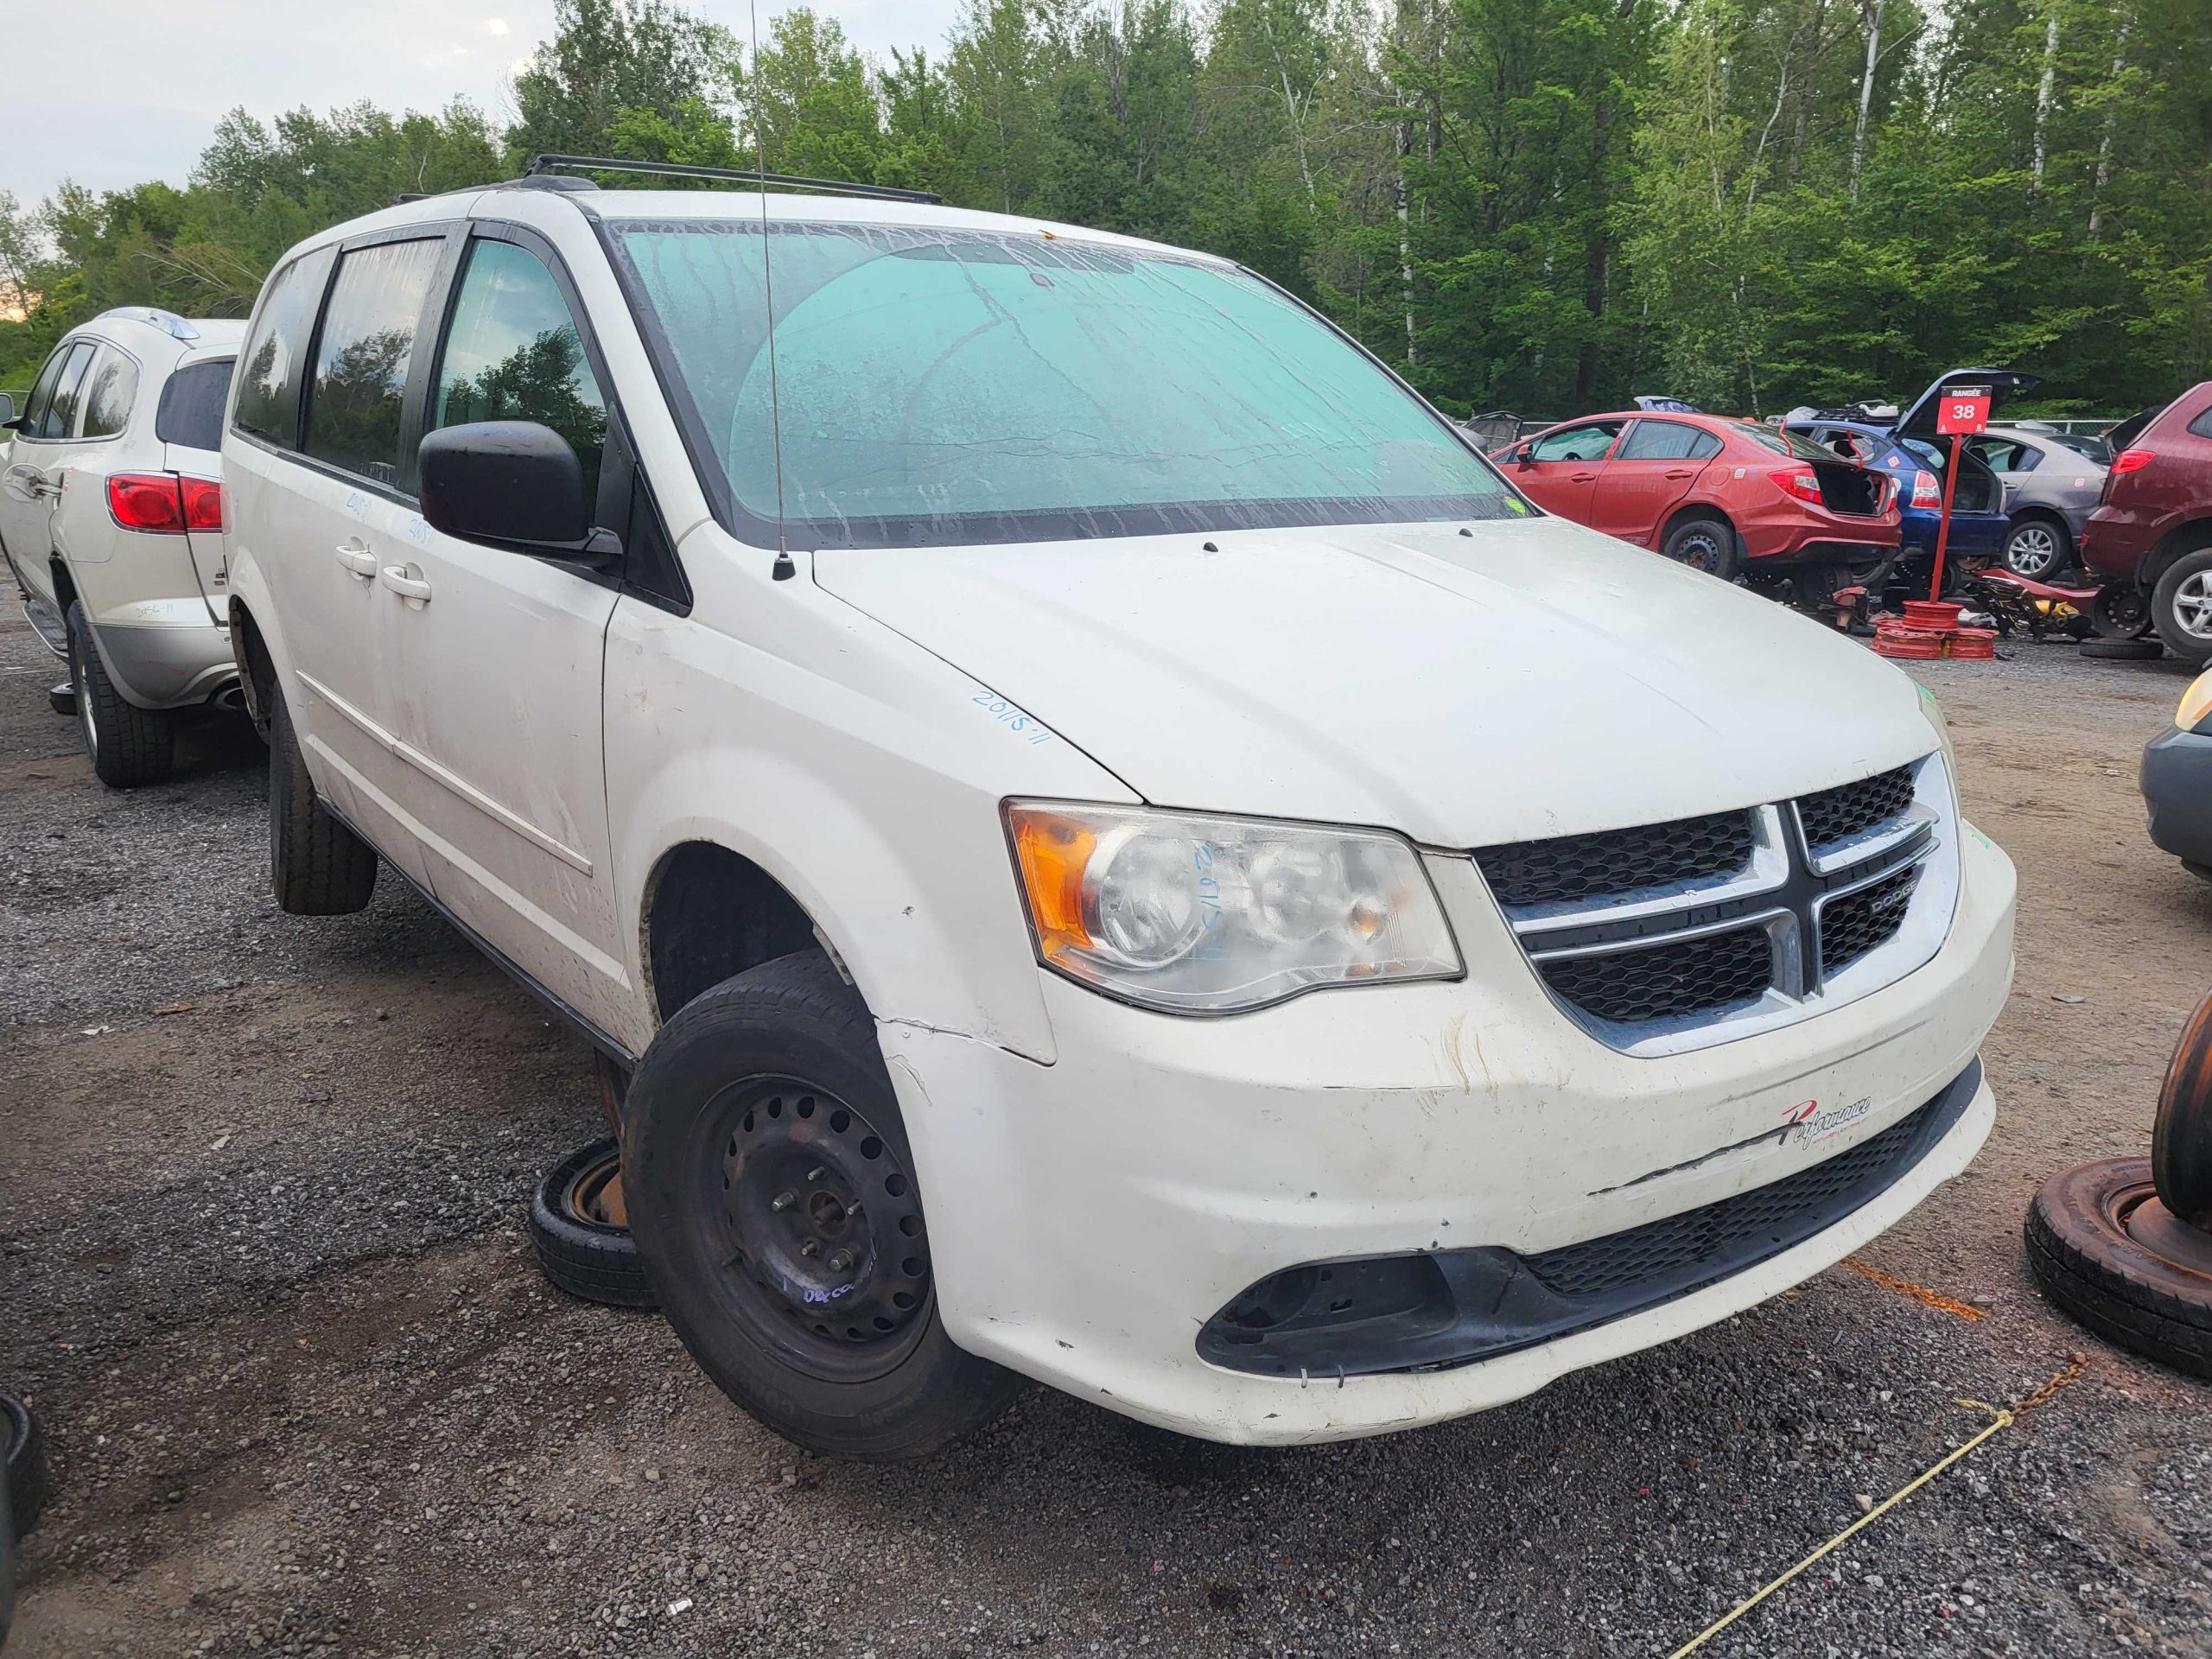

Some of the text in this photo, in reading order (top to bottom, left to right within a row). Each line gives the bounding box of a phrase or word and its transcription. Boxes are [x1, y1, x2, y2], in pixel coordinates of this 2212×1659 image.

[1952, 388, 1982, 397] RANGÉE
[1953, 404, 1975, 419] 38
[1872, 880, 1917, 913] DODGE
[1778, 1096, 1872, 1151] Performance
